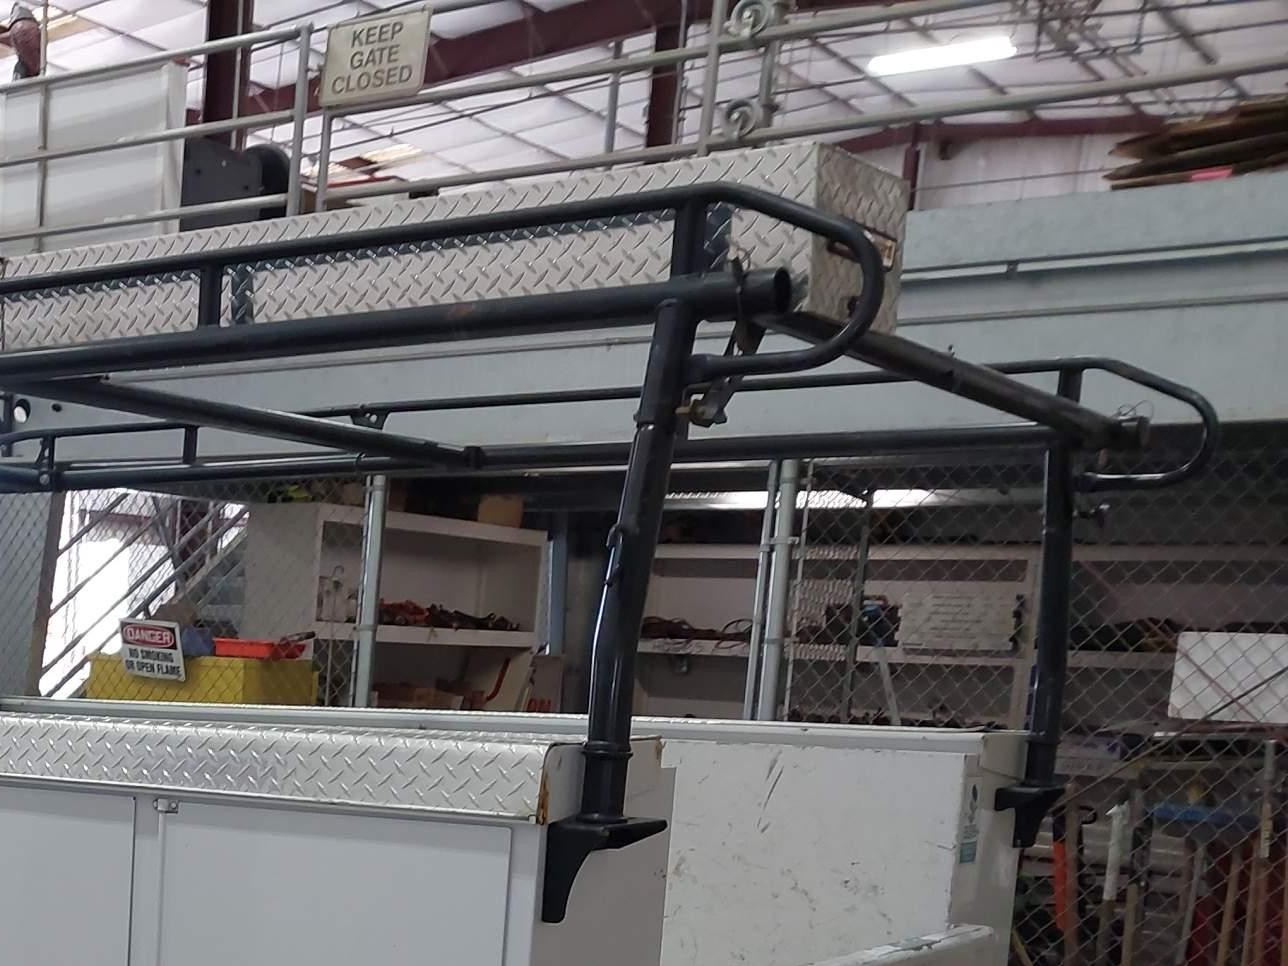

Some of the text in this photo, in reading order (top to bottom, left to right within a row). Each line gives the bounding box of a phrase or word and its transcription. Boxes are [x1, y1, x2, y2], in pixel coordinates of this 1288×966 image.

[351, 21, 403, 48] KEEP
[350, 44, 400, 69] GATE
[332, 64, 412, 94] CLOSED
[127, 627, 171, 644] DANGER
[129, 648, 174, 663] NO SMOKING
[126, 659, 180, 675] OR OPEN FLAME
